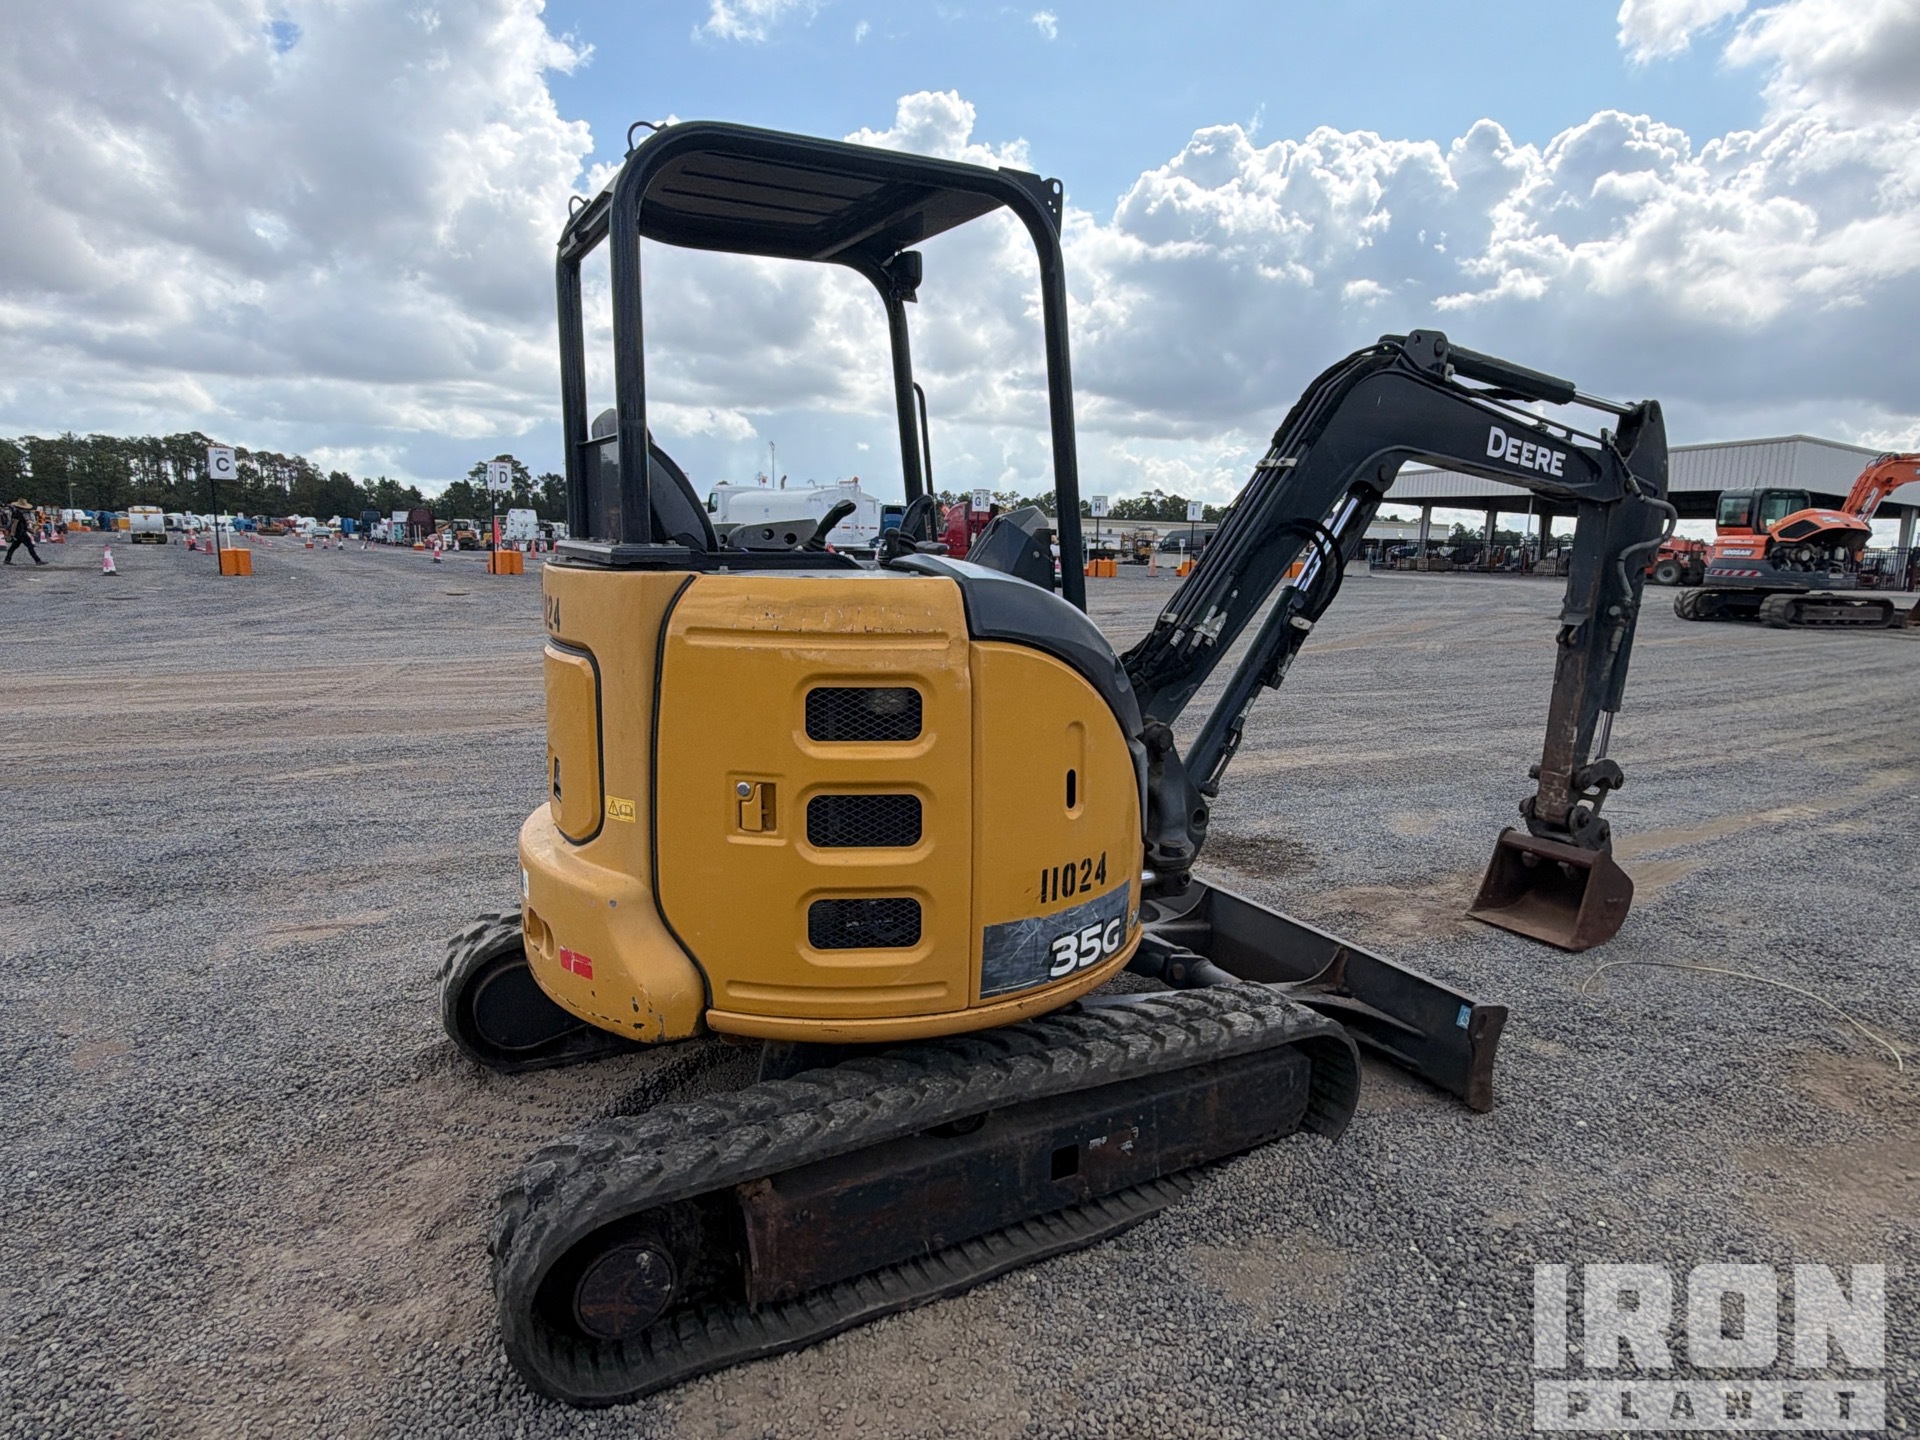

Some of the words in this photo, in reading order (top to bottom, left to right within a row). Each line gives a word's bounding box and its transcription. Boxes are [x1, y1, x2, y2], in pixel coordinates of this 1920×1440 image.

[1486, 426, 1566, 477] DEERE
[215, 457, 230, 472] C
[499, 471, 508, 484] D
[975, 496, 982, 507] G
[1094, 502, 1102, 513] H
[1040, 851, 1106, 904] 11024
[1050, 917, 1121, 977] 35G
